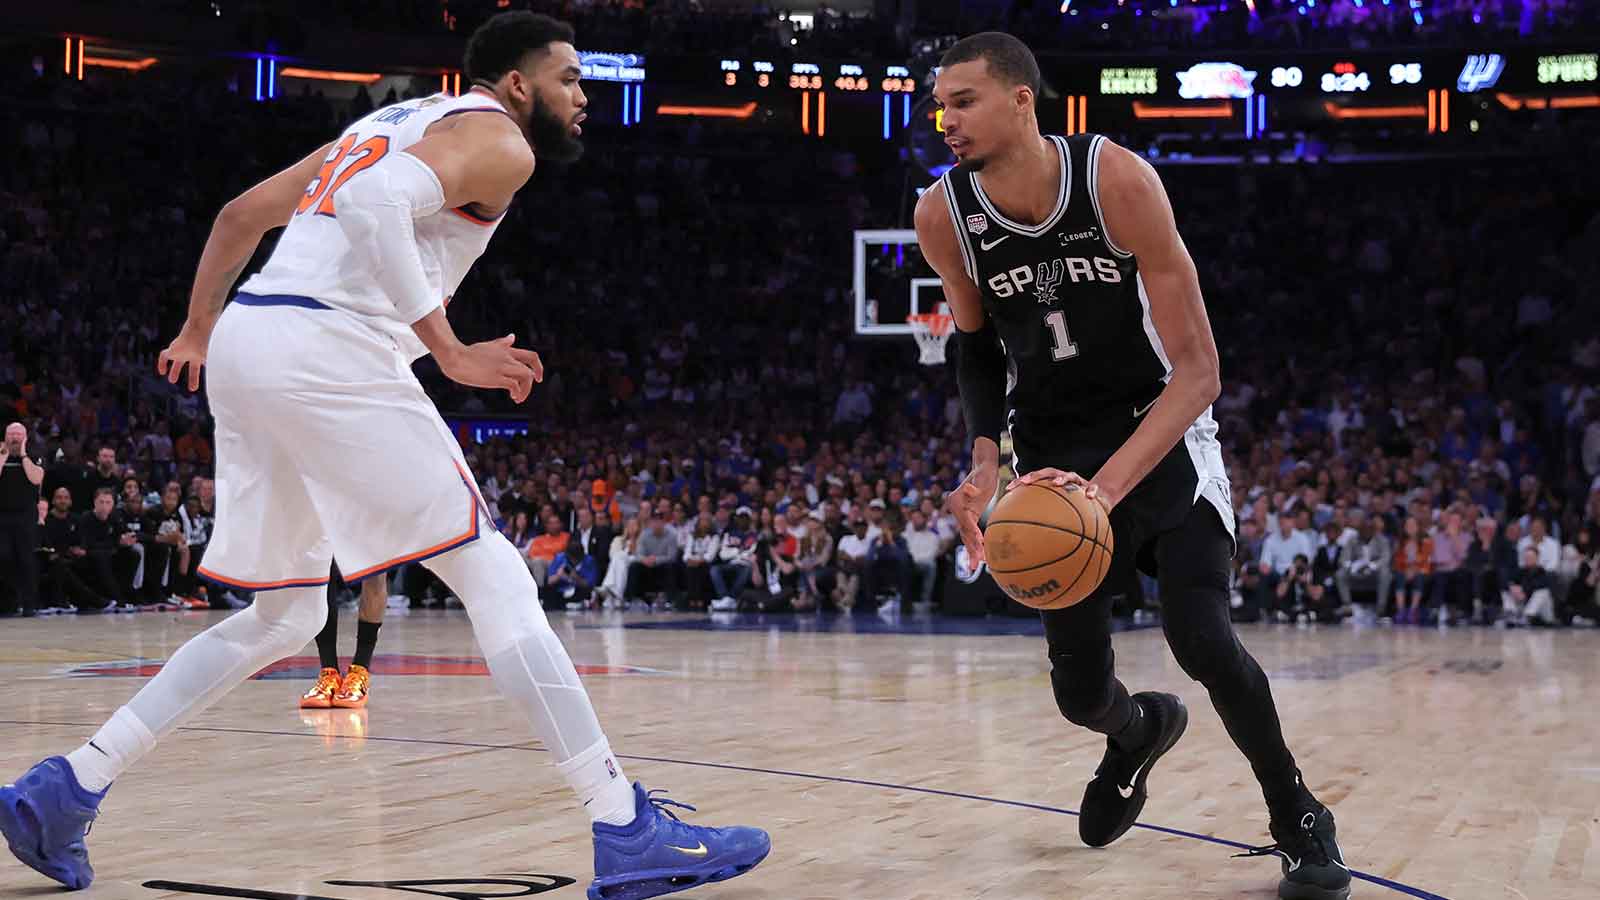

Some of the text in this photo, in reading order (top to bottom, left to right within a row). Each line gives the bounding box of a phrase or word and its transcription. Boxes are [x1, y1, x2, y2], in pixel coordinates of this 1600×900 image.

[725, 73, 736, 86] 3
[758, 74, 769, 87] 3
[1389, 63, 1422, 84] 95
[1537, 62, 1598, 83] SPURS
[1100, 76, 1158, 94] KNICKS
[296, 132, 390, 219] 32
[1064, 231, 1094, 242] LEDGER
[988, 256, 1121, 305] SPURS
[1044, 310, 1079, 362] 1
